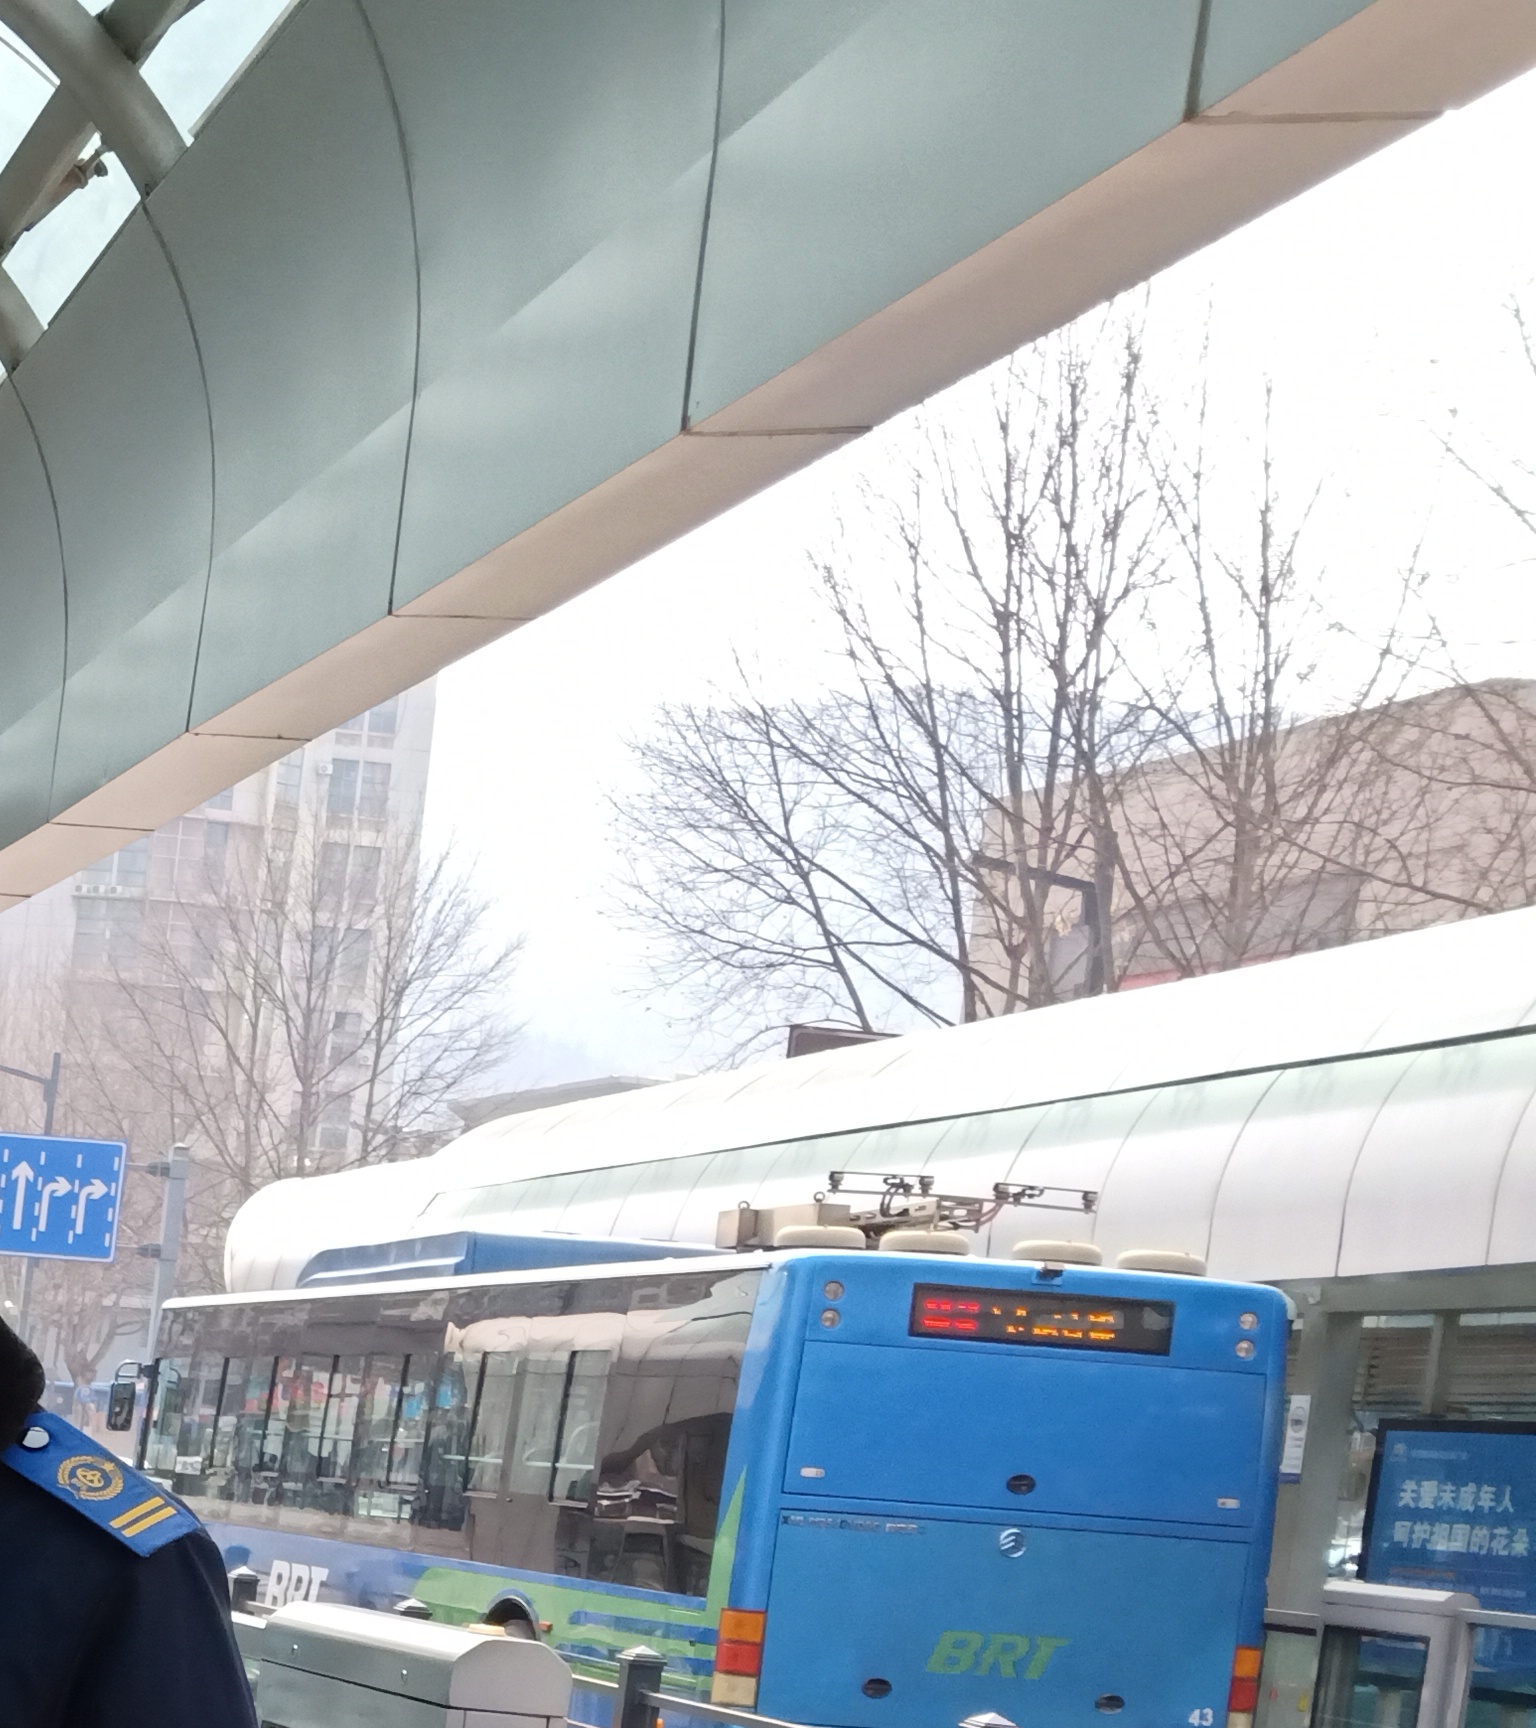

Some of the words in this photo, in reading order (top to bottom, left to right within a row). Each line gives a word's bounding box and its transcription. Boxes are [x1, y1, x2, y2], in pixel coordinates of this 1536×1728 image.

[1398, 1479, 1514, 1514] 关爱未成年人
[1393, 1520, 1529, 1557] 呵护祖国的花朵
[926, 1630, 1073, 1680] BRT
[1188, 1707, 1214, 1727] 43
